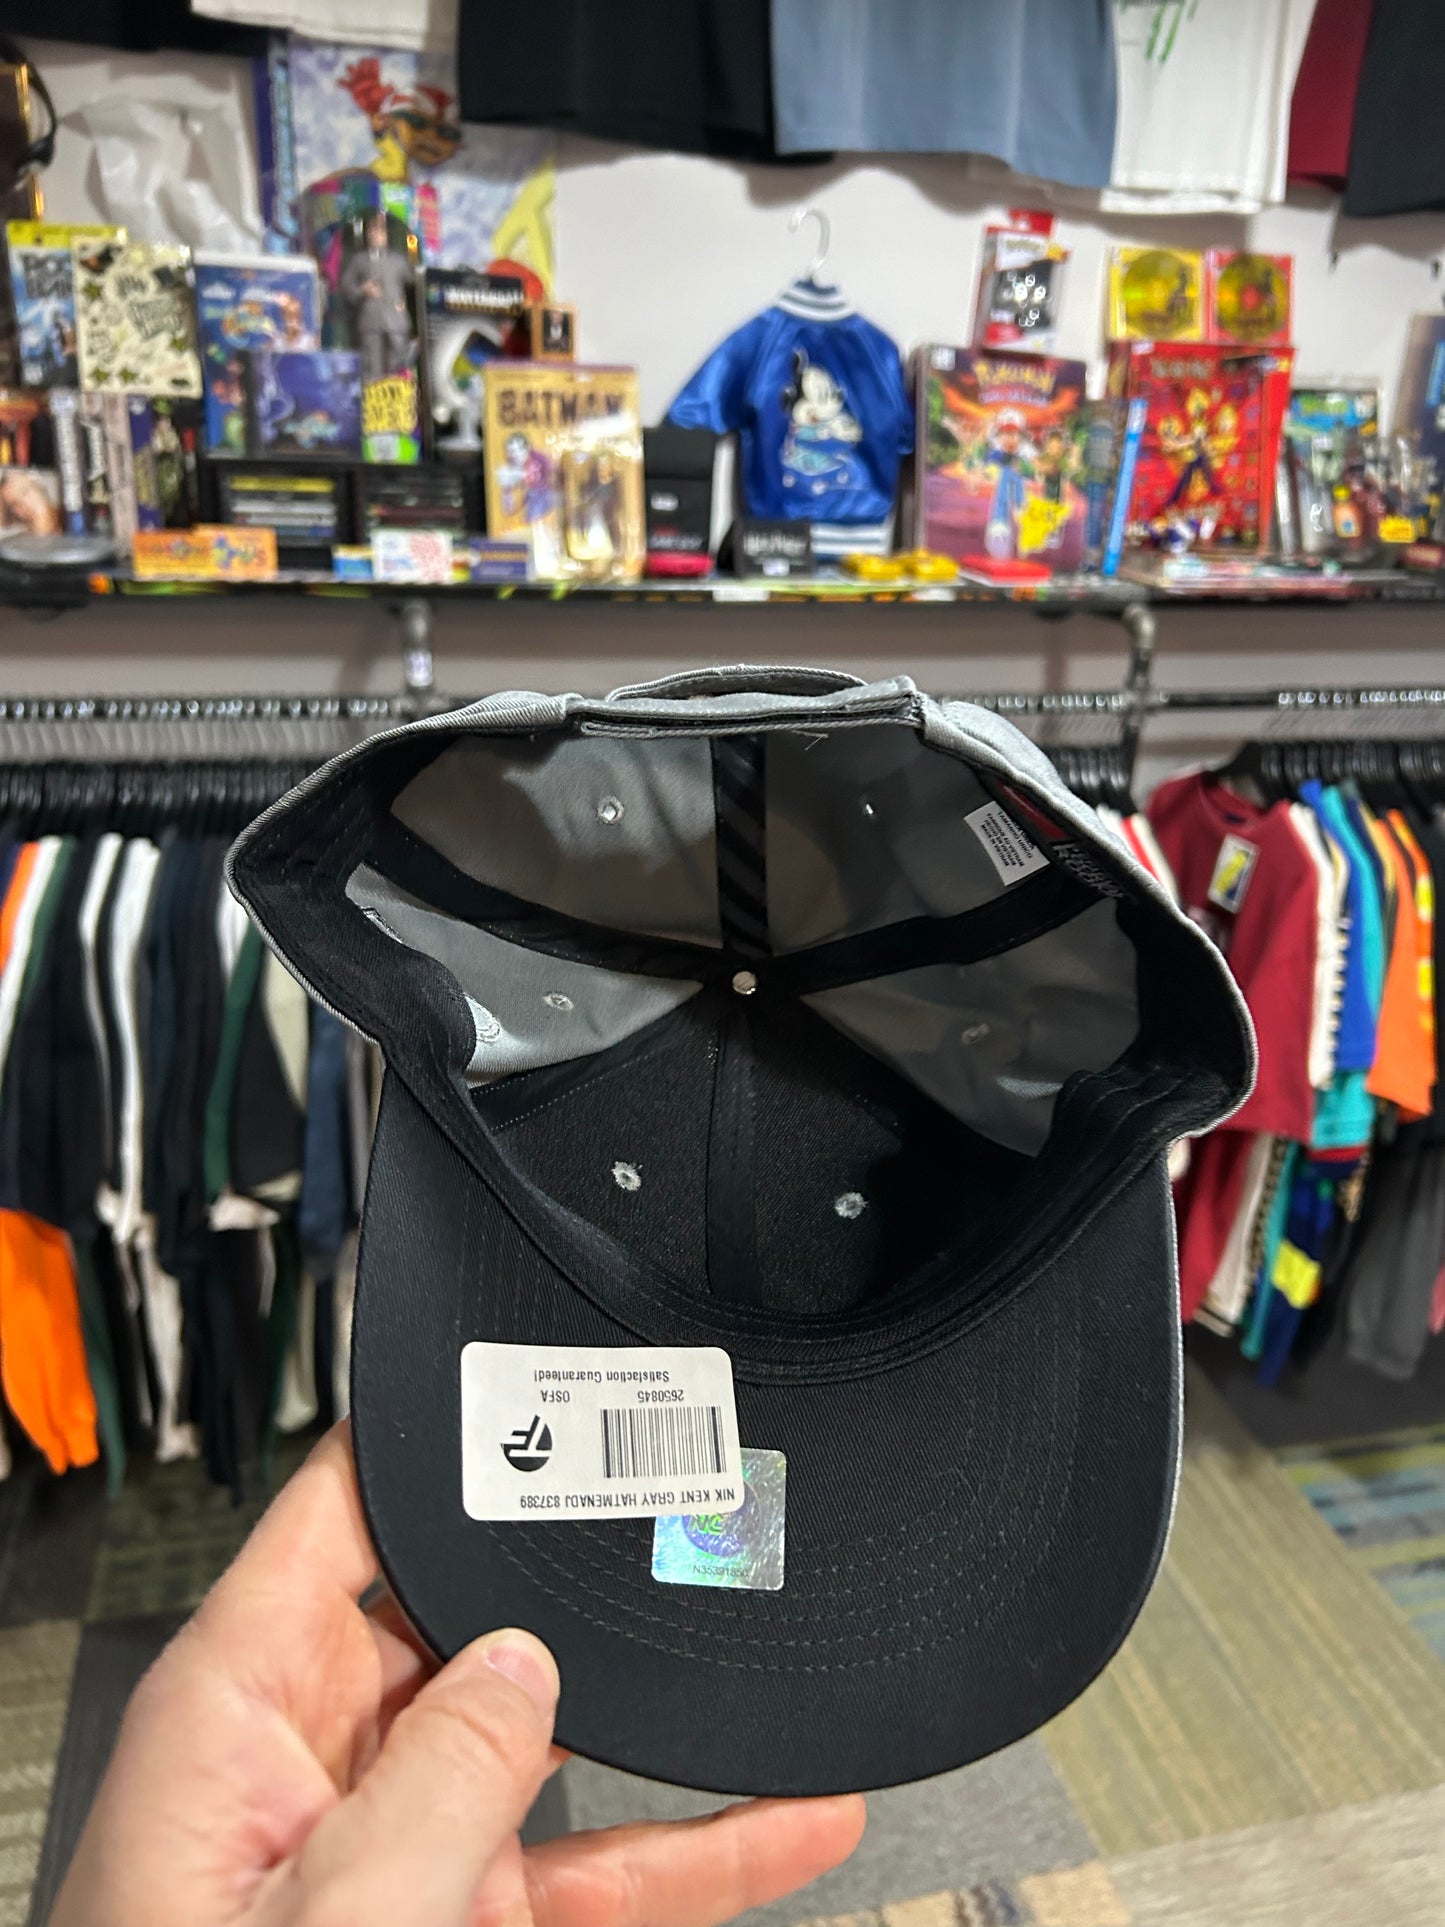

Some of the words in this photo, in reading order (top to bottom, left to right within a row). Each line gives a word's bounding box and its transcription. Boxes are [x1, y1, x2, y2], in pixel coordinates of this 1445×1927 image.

[534, 1369, 602, 1382] Guaranteed!
[606, 1370, 670, 1382] Satisfaction
[540, 1389, 571, 1402] OSFA
[637, 1389, 684, 1402] 2650845
[565, 1493, 637, 1508] HATMENADJ
[642, 1491, 675, 1504] GRAY
[679, 1489, 711, 1502] KENT
[715, 1488, 736, 1501] NIK
[520, 1495, 561, 1508] 837389
